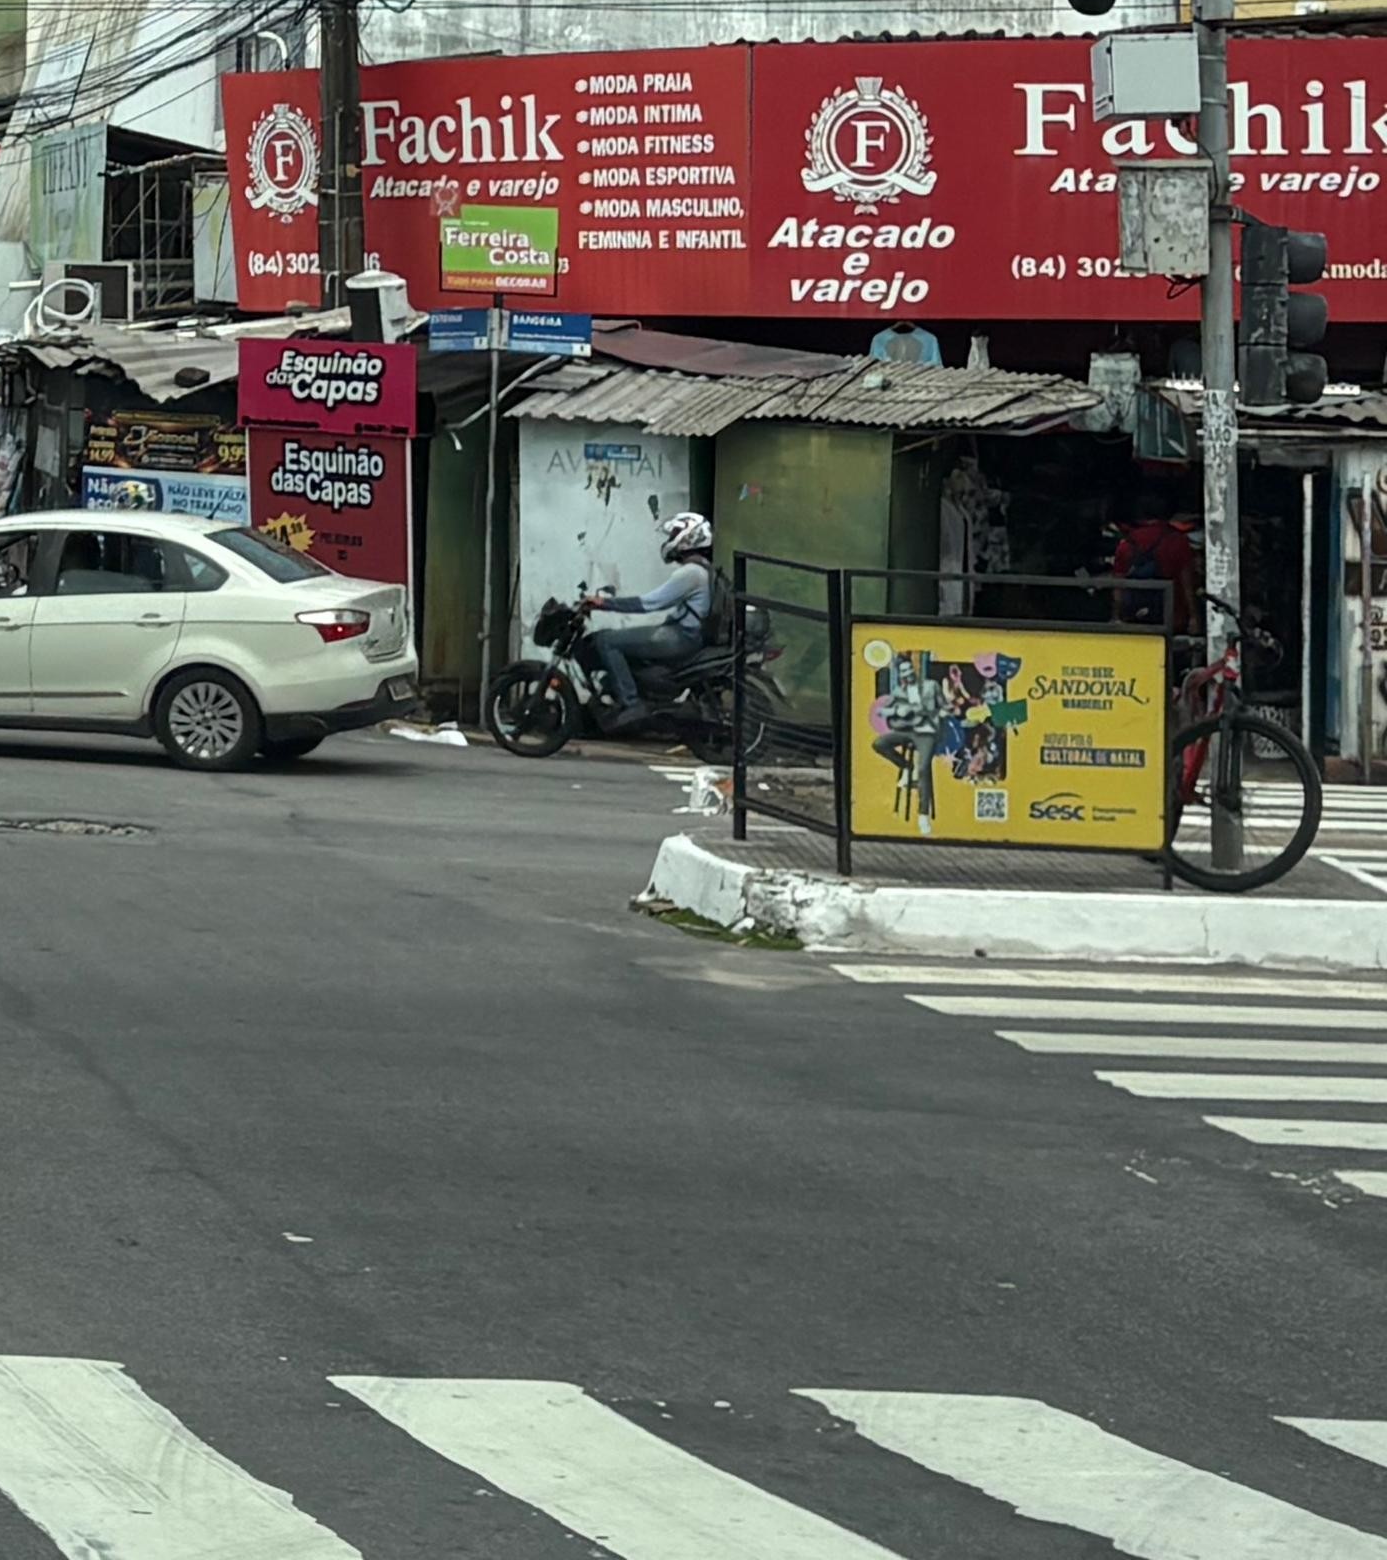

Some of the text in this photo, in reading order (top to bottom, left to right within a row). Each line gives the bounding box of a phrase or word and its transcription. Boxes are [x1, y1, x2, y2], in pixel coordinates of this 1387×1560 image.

[590, 73, 693, 95] MODA PRAIA
[590, 104, 703, 126] MODA INTIMA
[359, 94, 564, 166] Fachik
[592, 134, 715, 156] MODA FITNESS
[466, 179, 481, 196] e
[488, 171, 560, 200] varejo
[593, 166, 736, 187] MODA ESPORTIVA
[1260, 166, 1380, 197] varejo
[594, 197, 745, 219] MODA MASCULINO,
[445, 227, 531, 247] Ferreira
[579, 229, 747, 249] FEMININA E INFANTIL
[767, 217, 955, 248] Atacado
[248, 251, 283, 277] (84)
[489, 247, 550, 265] Costa
[842, 252, 870, 276] e
[1011, 254, 1067, 280] (84)
[790, 271, 929, 310] varejo
[281, 350, 383, 378] Esquinão
[265, 368, 379, 408] das Capas
[285, 442, 384, 480] Esquinão
[167, 483, 191, 495] NÃO
[193, 487, 215, 499] LEVE
[271, 466, 372, 510] das Capas
[173, 498, 188, 508] NO
[1027, 675, 1150, 705] SANDOVAL
[1043, 733, 1093, 747] NOVO POLO
[1043, 748, 1093, 764] CULTURAL
[1109, 752, 1142, 765] NATAL
